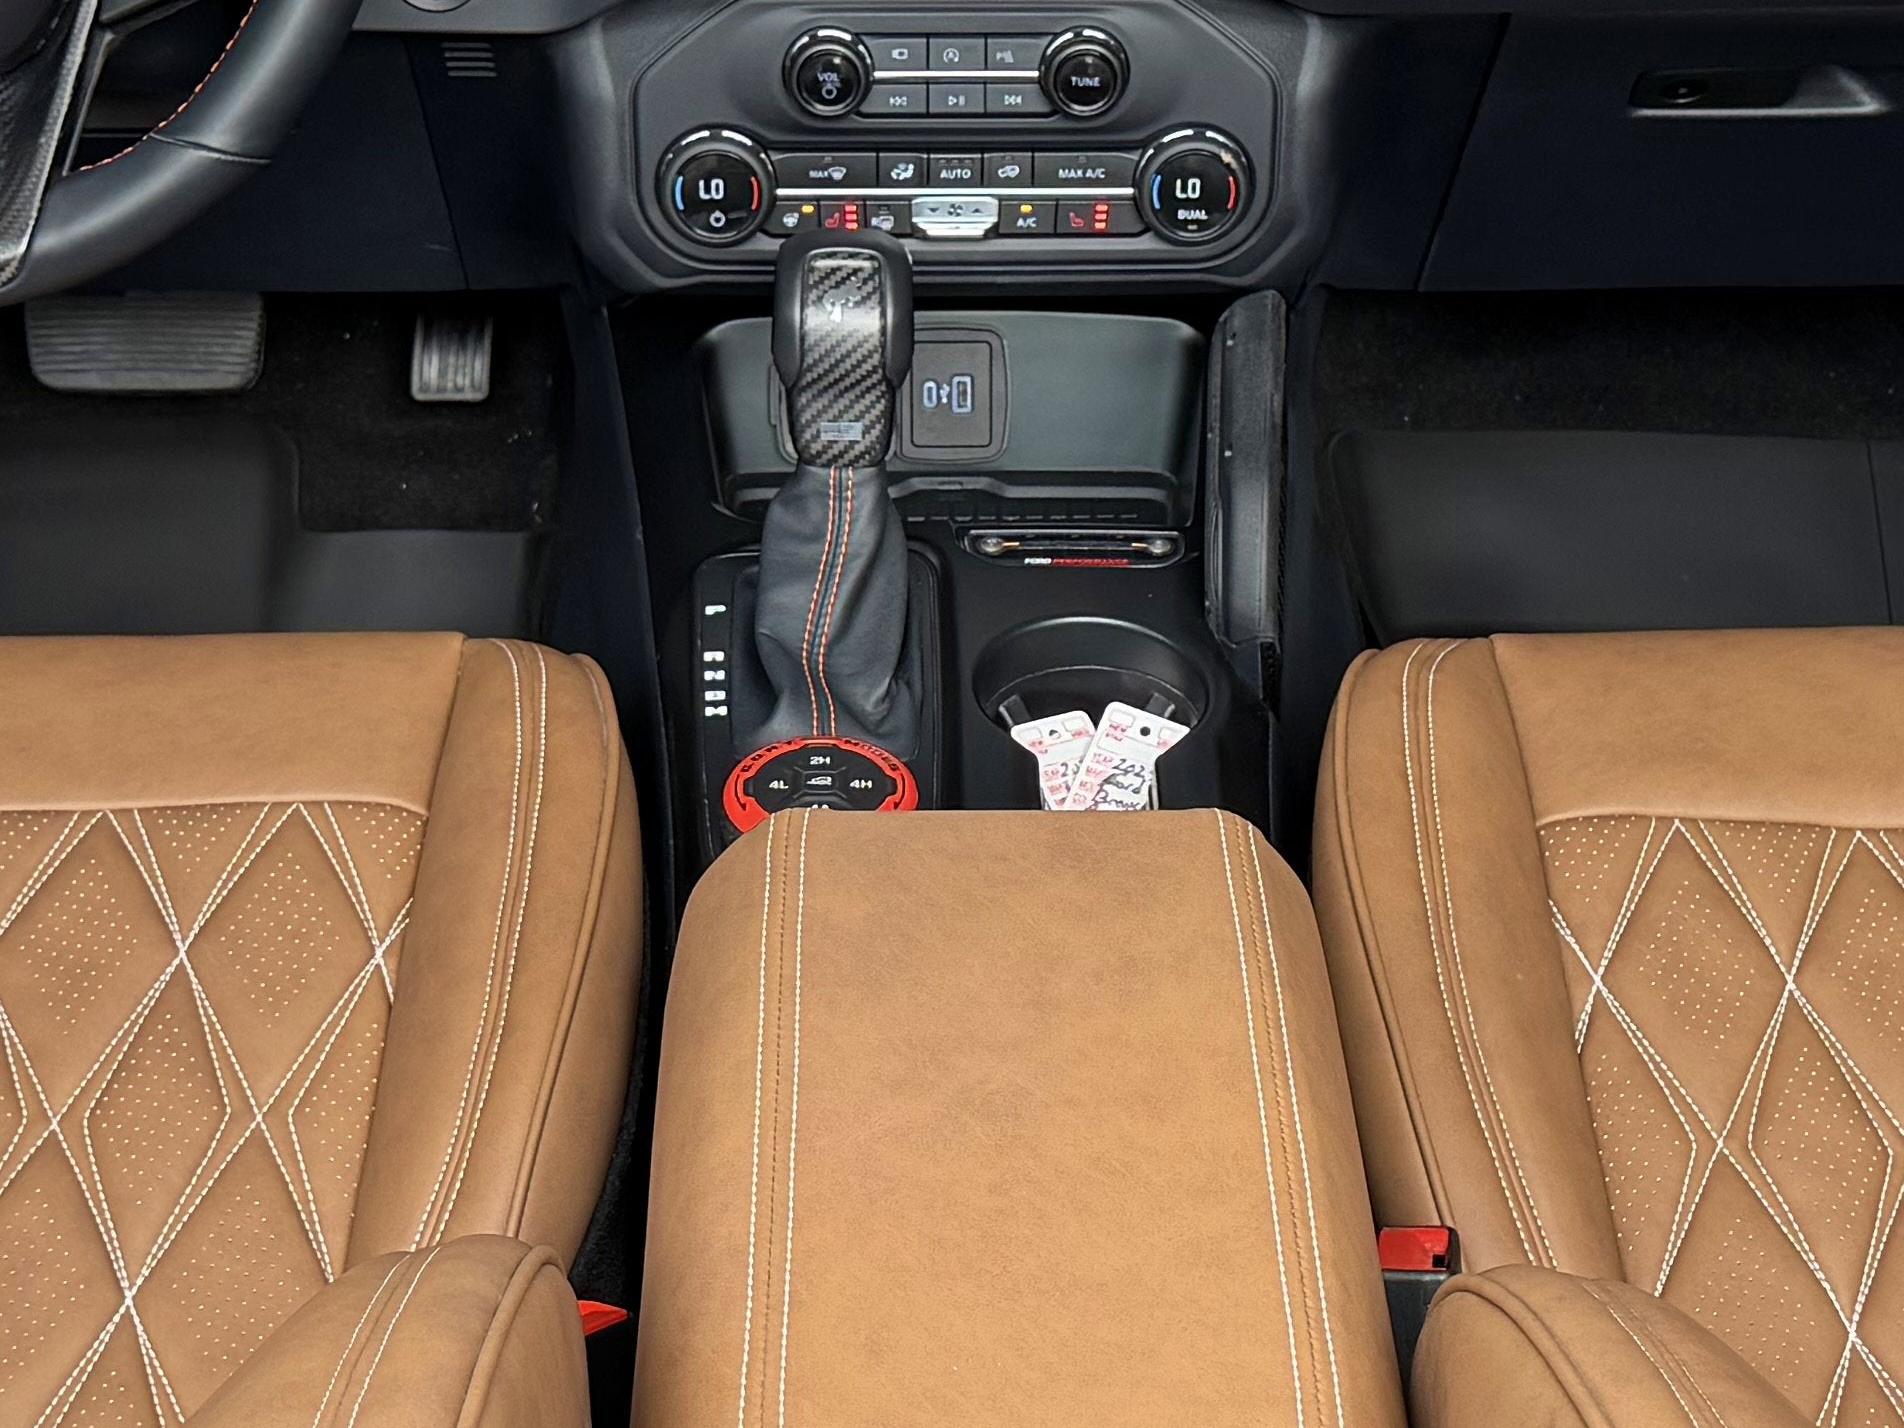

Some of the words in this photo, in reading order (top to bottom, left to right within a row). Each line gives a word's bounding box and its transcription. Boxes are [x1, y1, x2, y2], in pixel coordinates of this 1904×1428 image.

[1070, 75, 1101, 88] TUNE
[939, 167, 972, 180] AUTO
[1058, 167, 1084, 180] MAX
[1085, 167, 1106, 180] A/C
[698, 178, 725, 200] LO
[1175, 178, 1201, 200] LO
[1177, 209, 1209, 221] DUAL
[1016, 218, 1037, 229] A/C
[809, 755, 832, 766] 2H
[768, 780, 790, 790] 4L
[849, 780, 873, 789] 4H
